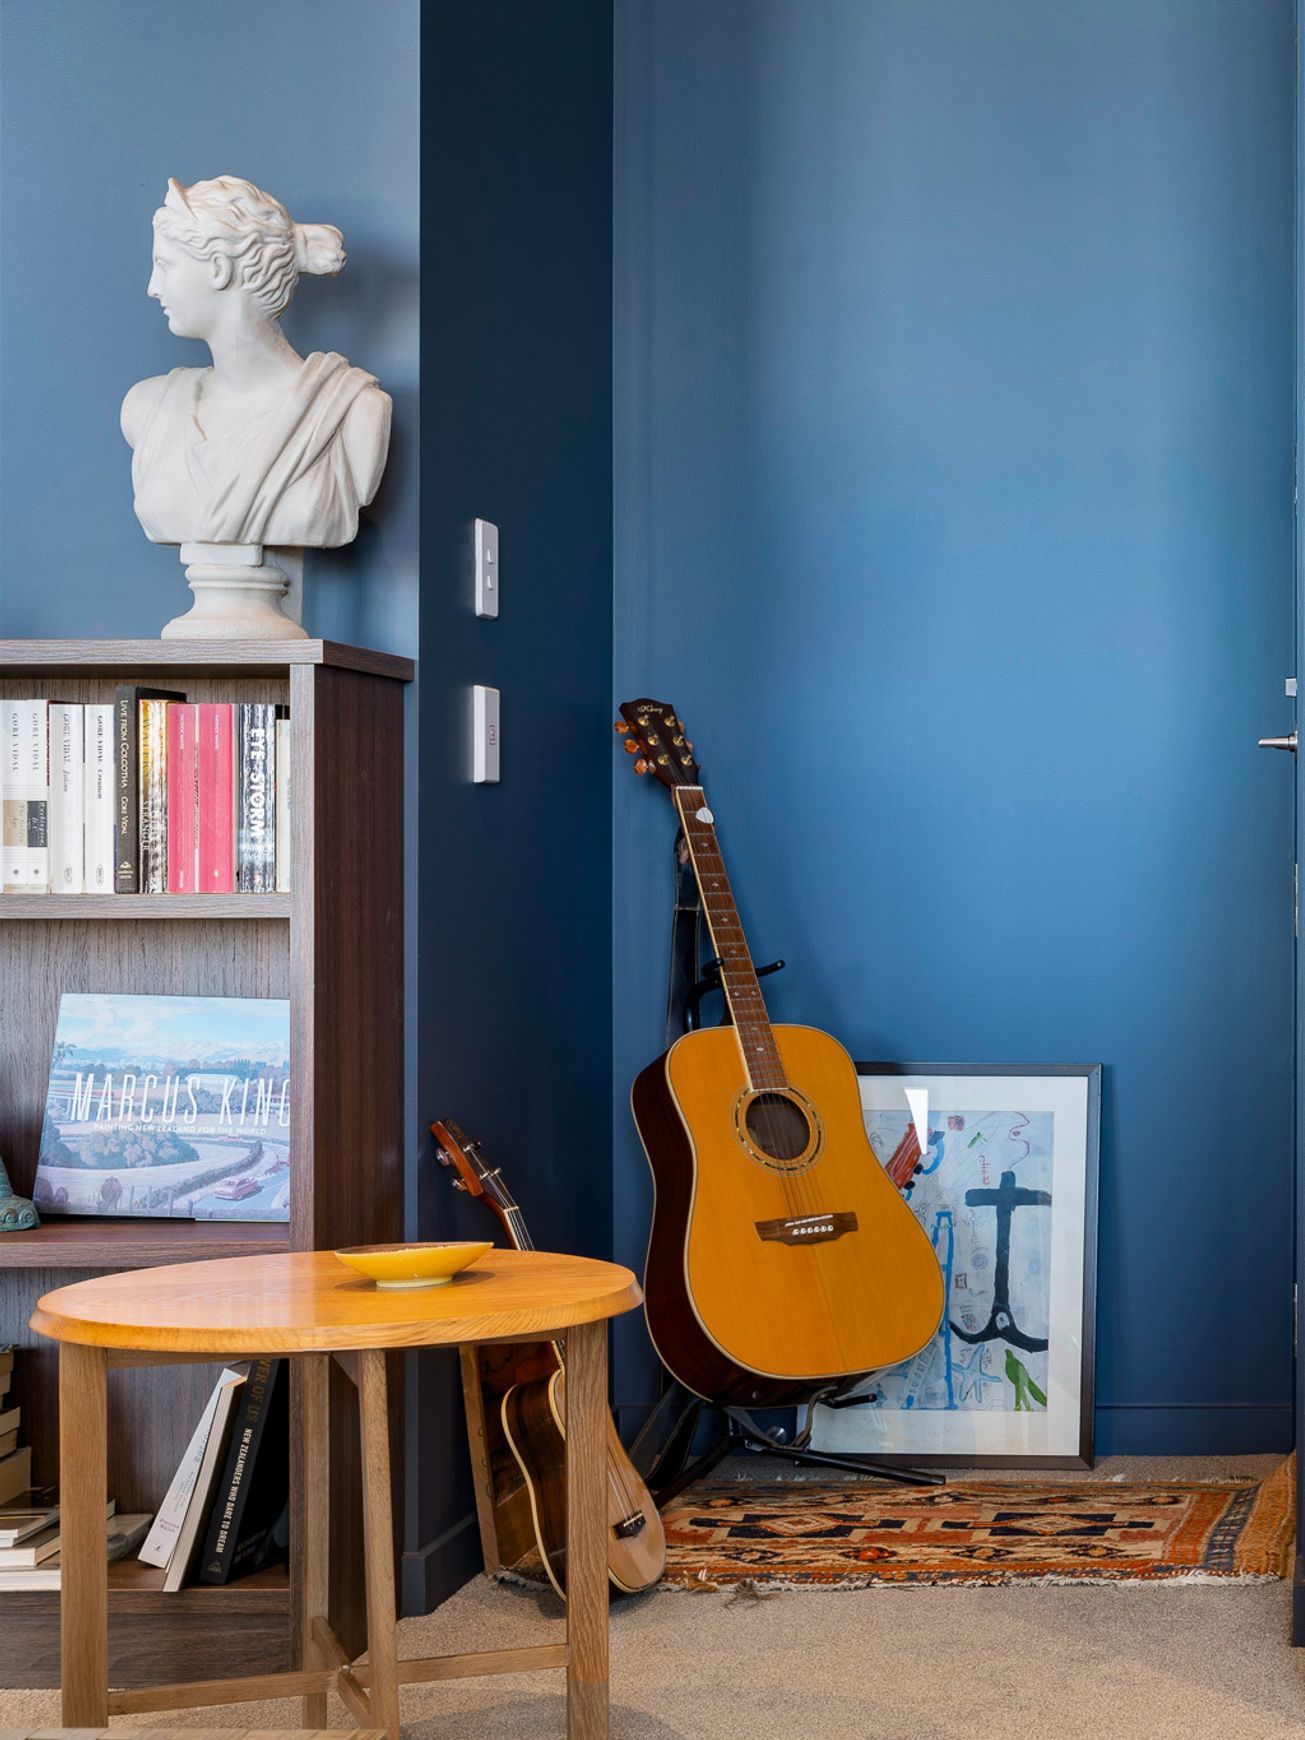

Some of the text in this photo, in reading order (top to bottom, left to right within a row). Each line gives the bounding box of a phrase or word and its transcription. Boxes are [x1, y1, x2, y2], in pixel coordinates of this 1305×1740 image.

[251, 729, 264, 759] EYE
[251, 774, 265, 836] STORM
[71, 1073, 200, 1123] MARCUS
[216, 1428, 252, 1553] NEW ZEALANDERS WHO DARE TO DREAM
